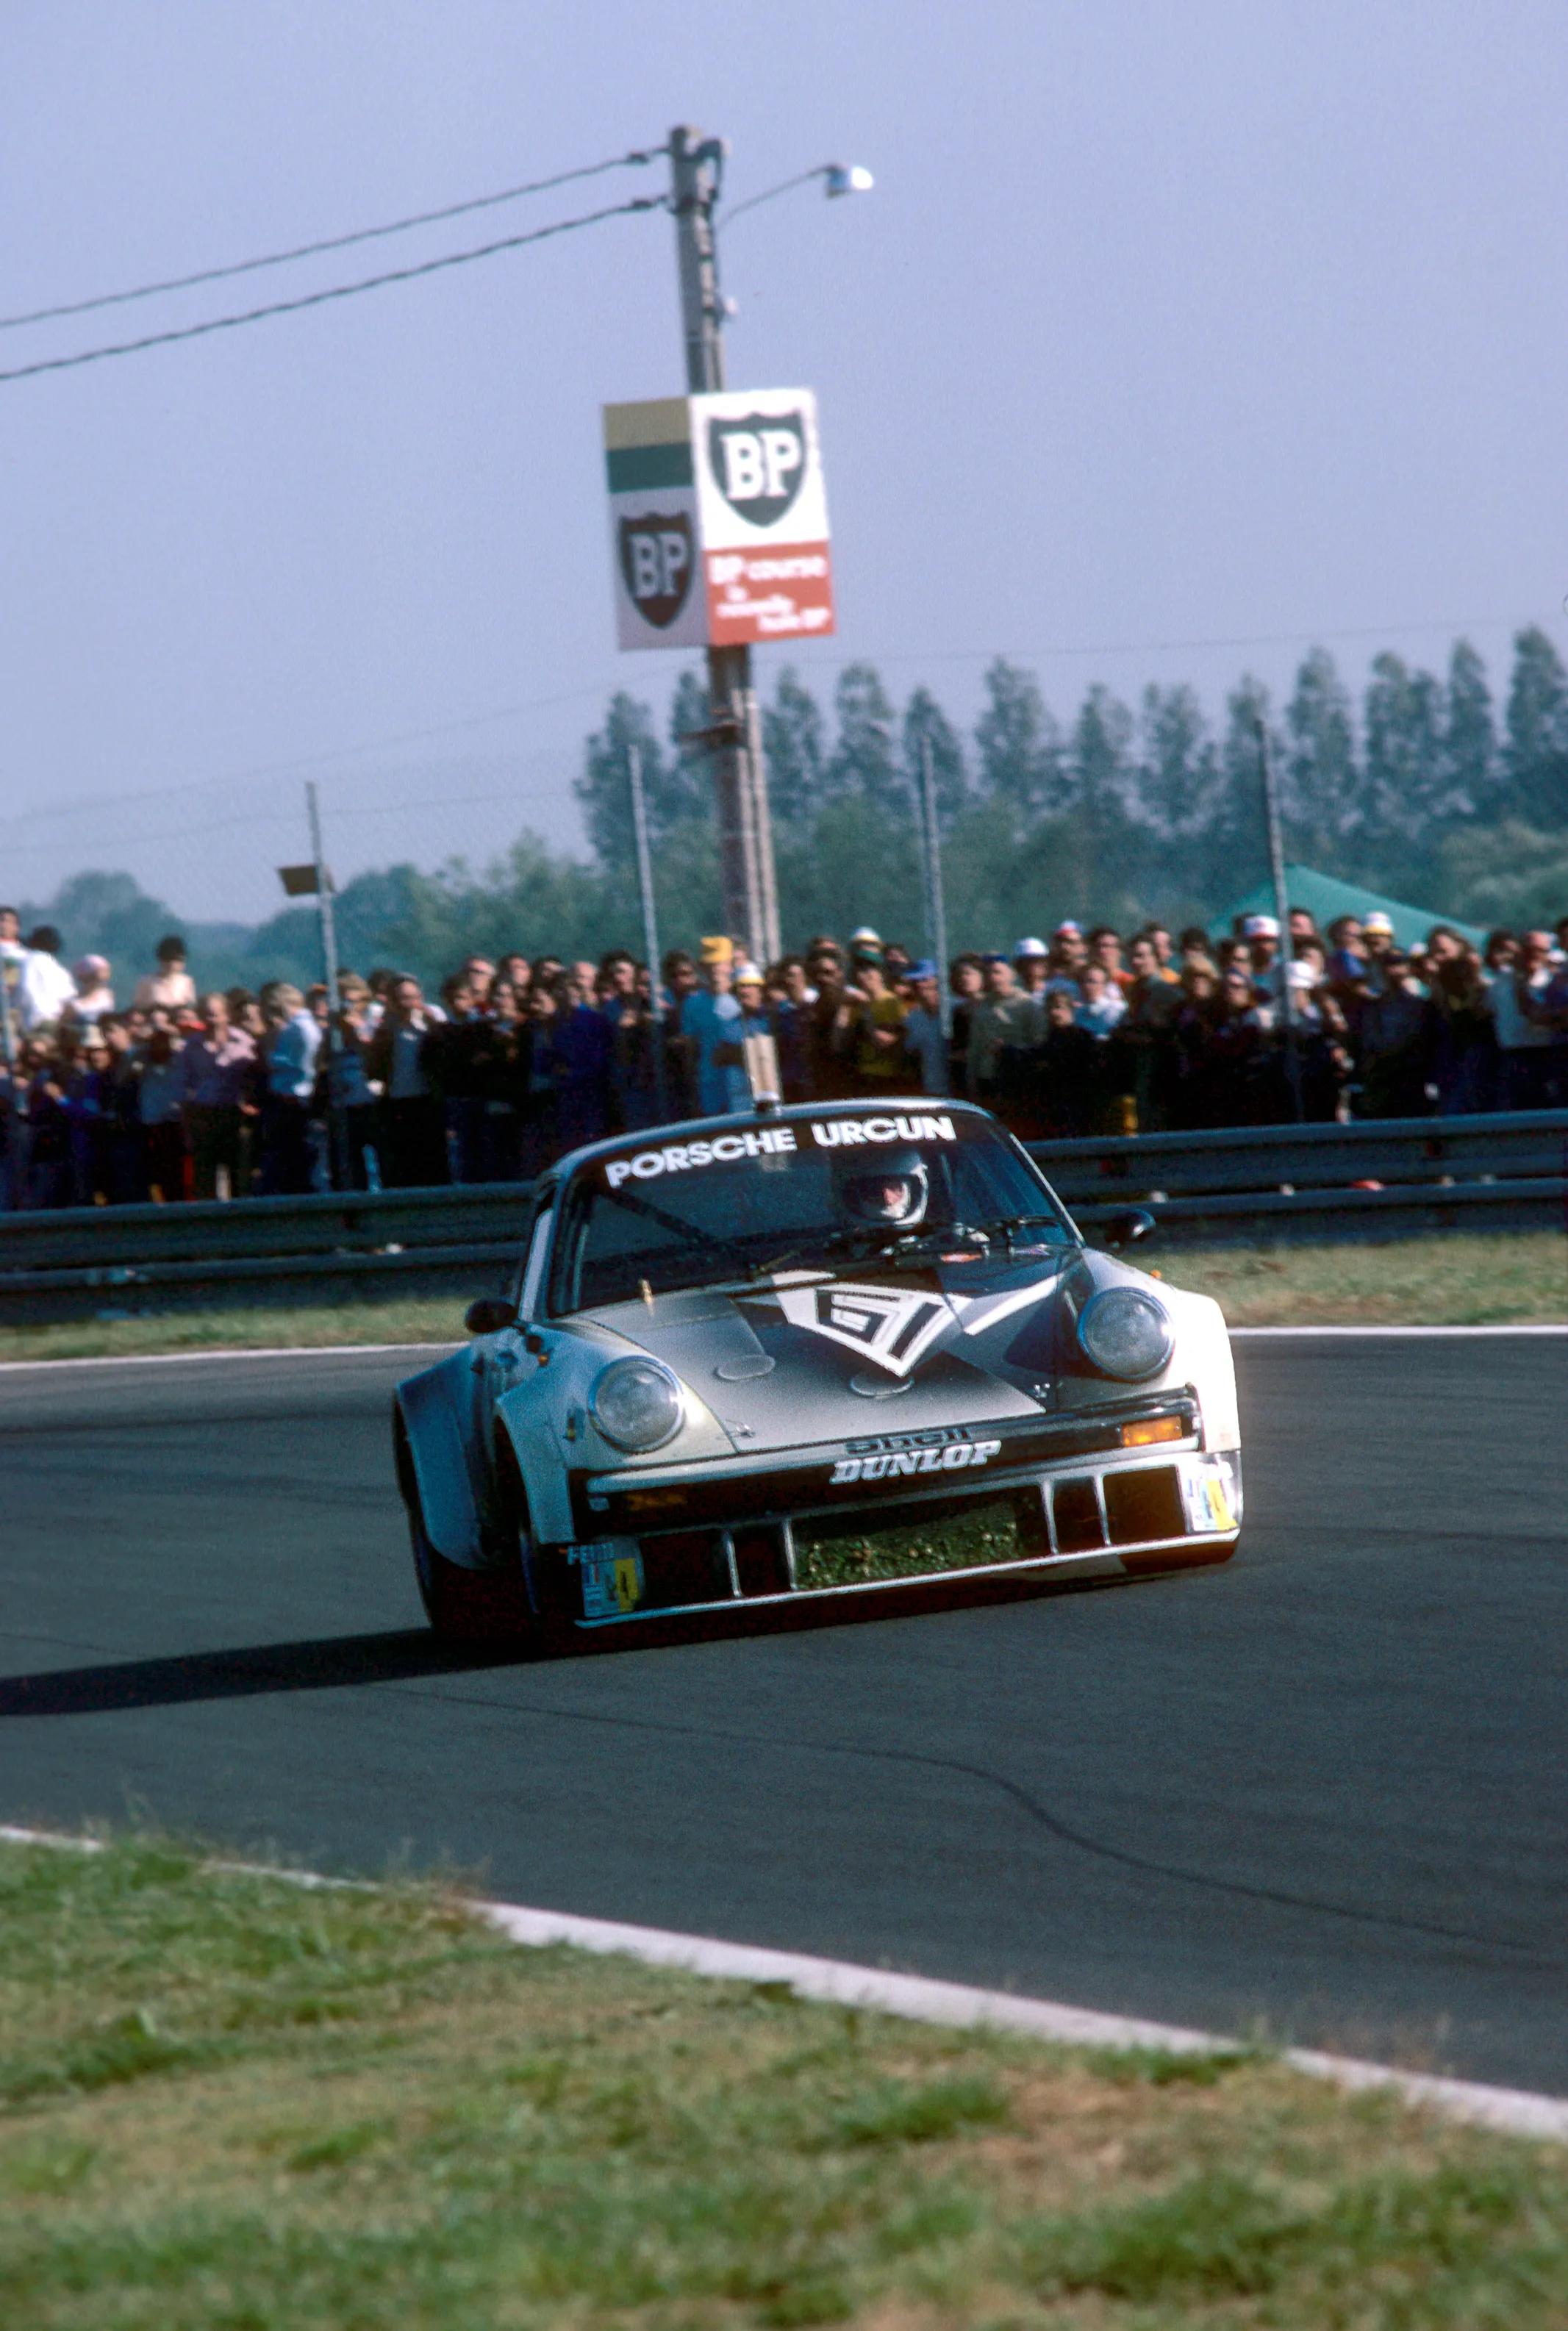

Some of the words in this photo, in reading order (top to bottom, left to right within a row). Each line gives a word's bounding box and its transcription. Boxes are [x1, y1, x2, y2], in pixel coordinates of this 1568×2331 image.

[720, 429, 802, 501] BP
[629, 531, 688, 599] BP
[605, 1126, 798, 1189] PORSCHE
[812, 1116, 957, 1147] URCUN
[829, 1439, 1002, 1485] DUNLOP
